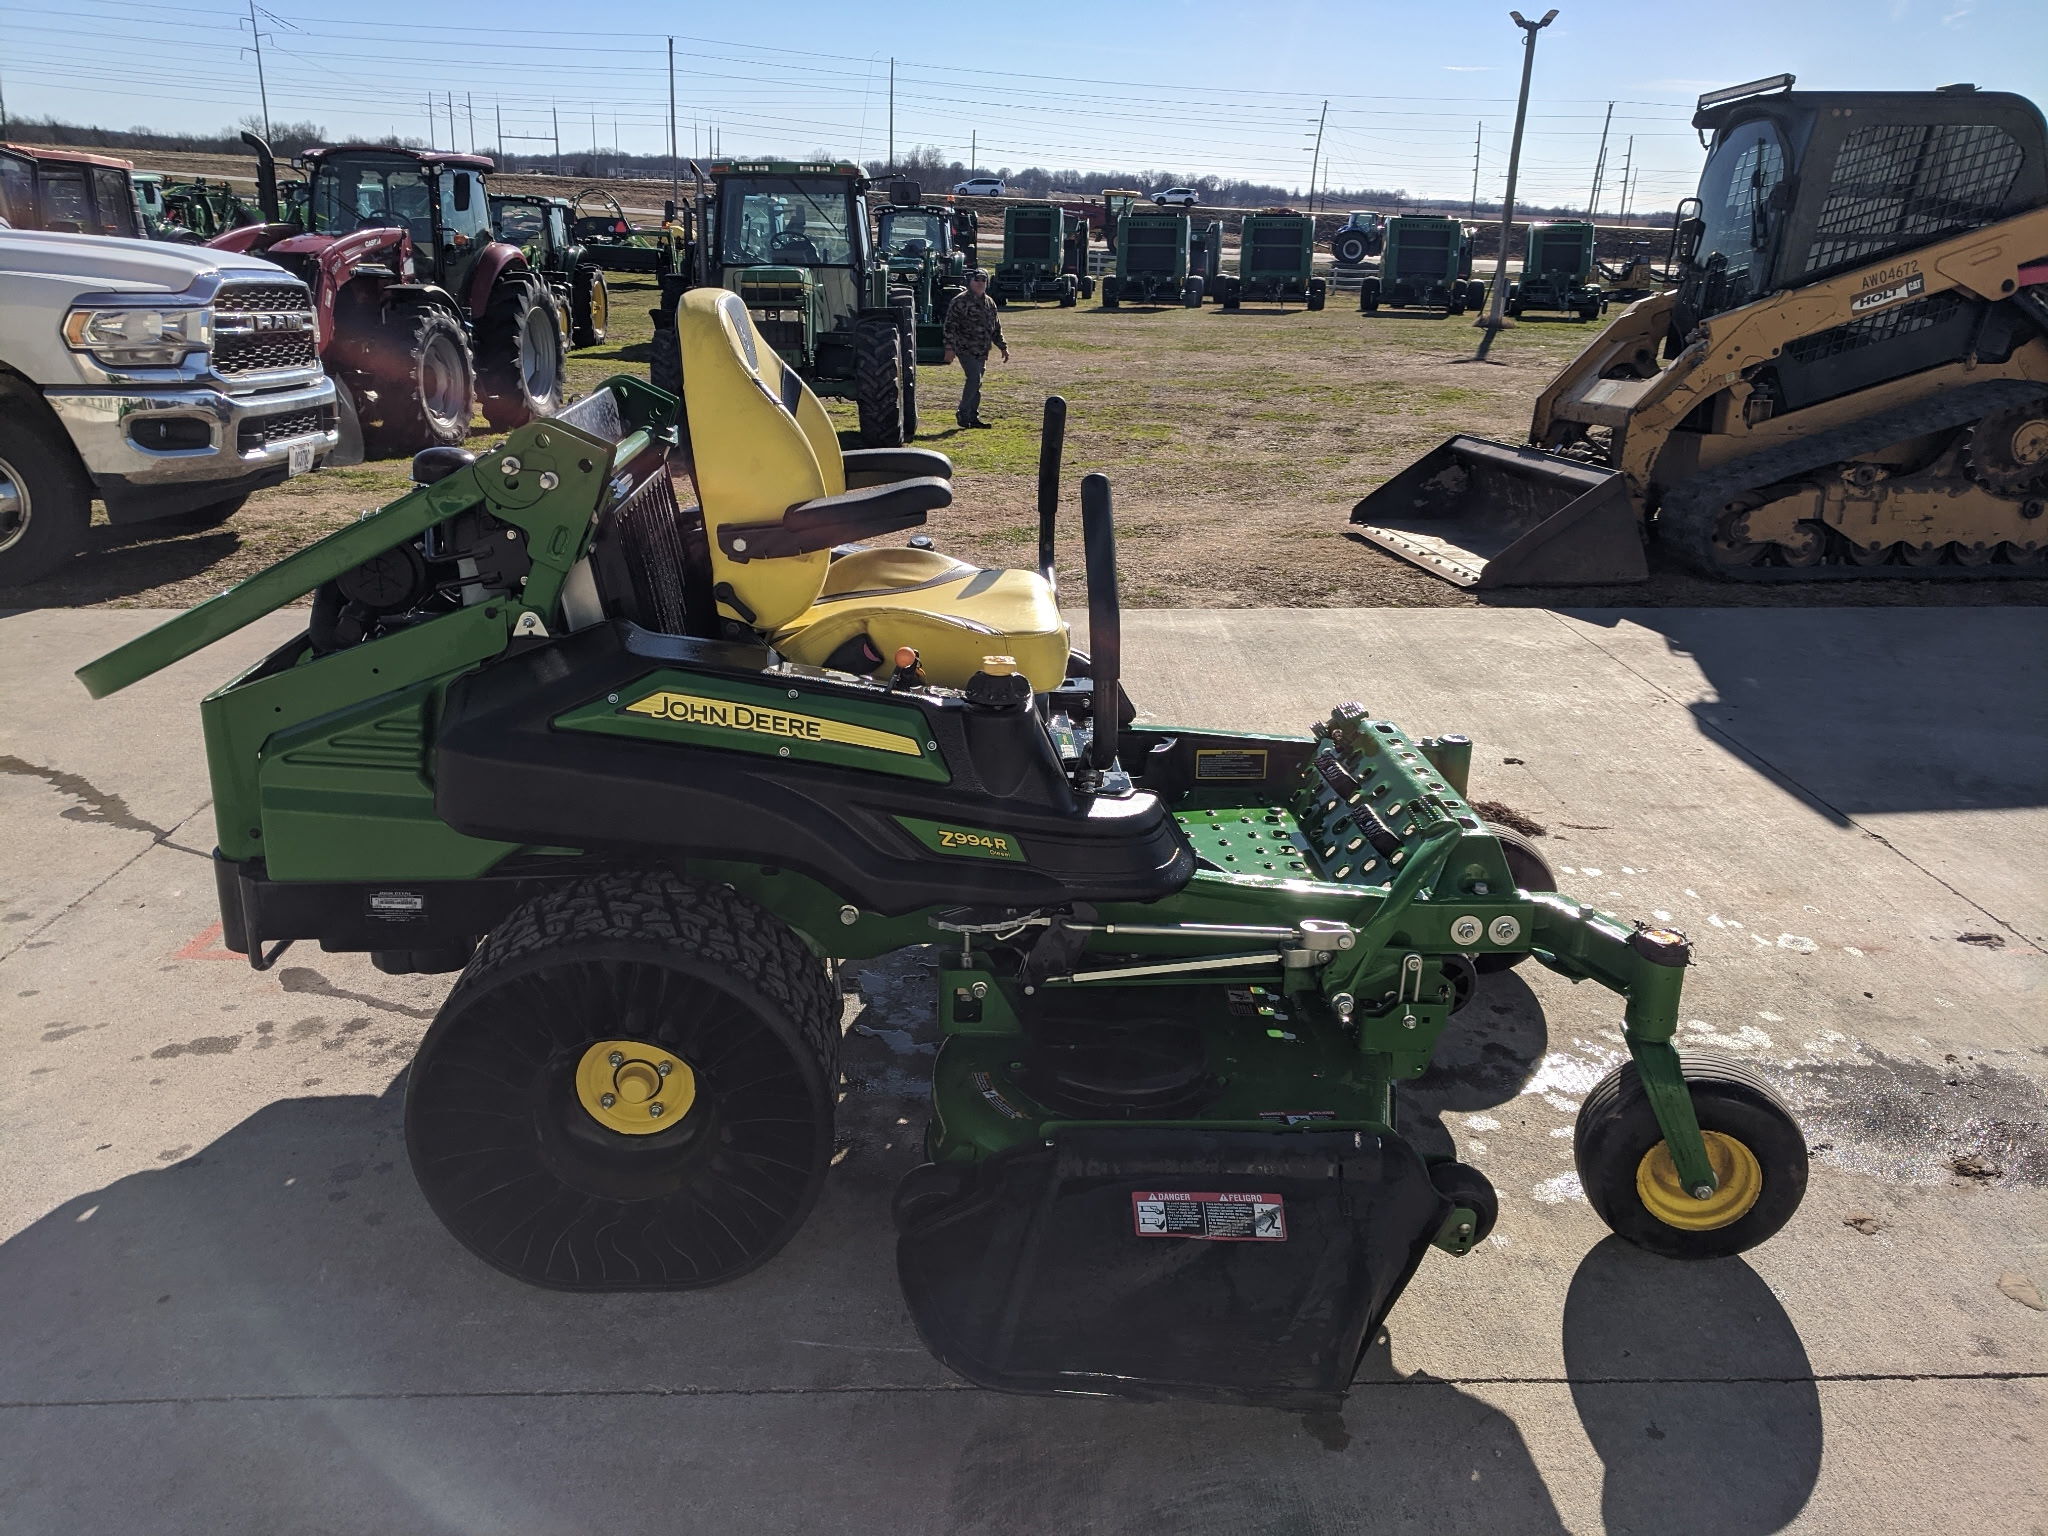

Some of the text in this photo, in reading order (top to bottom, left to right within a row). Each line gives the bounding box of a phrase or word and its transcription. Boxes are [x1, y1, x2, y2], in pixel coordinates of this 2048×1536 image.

[1860, 287, 1898, 307] HOLT
[256, 314, 303, 329] RAM
[654, 696, 821, 738] JOHN DEERE
[938, 830, 1008, 851] Z994R
[1157, 1193, 1191, 1201] DANGER
